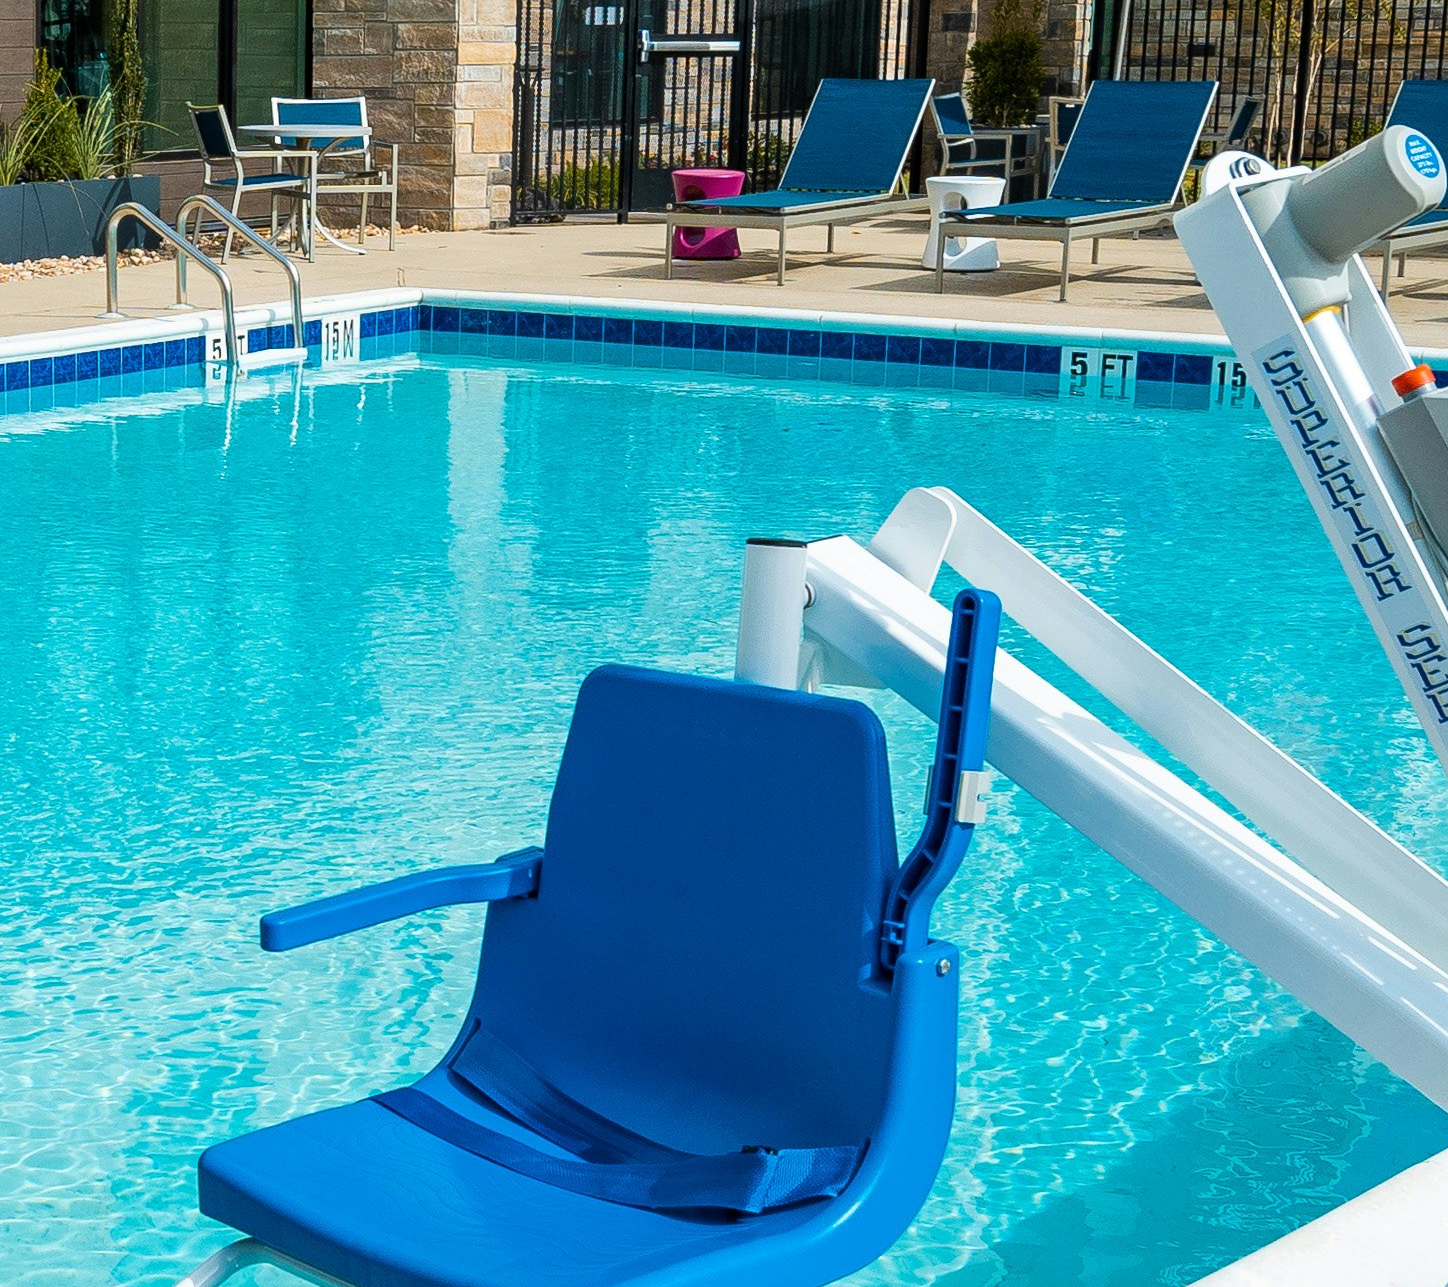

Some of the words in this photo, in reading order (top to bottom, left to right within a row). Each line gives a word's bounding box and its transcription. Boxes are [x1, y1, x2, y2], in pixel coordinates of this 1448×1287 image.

[1070, 351, 1088, 377] 5
[1103, 353, 1134, 379] FT
[1261, 349, 1413, 603] SUPERIOR
